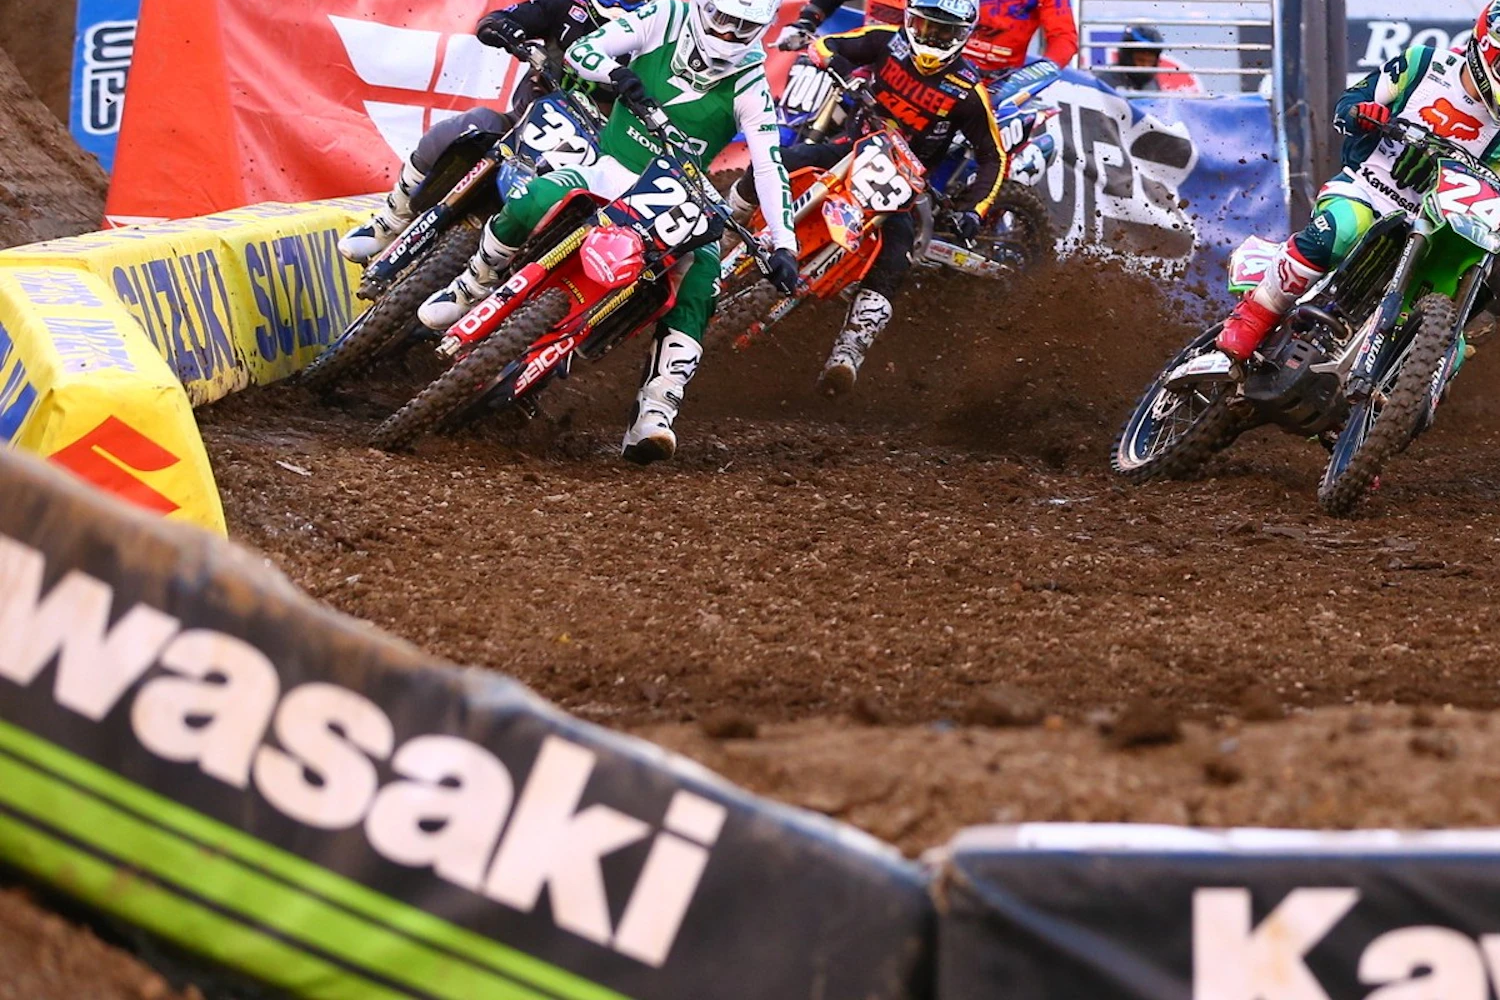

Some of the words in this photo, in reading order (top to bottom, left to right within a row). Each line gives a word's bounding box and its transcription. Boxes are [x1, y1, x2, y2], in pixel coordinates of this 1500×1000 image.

[625, 125, 663, 155] HON
[875, 90, 931, 132] KTM
[621, 175, 710, 247] 23
[850, 144, 913, 212] 123
[112, 248, 240, 384] SUZUKI
[244, 227, 354, 365] SUZUKI
